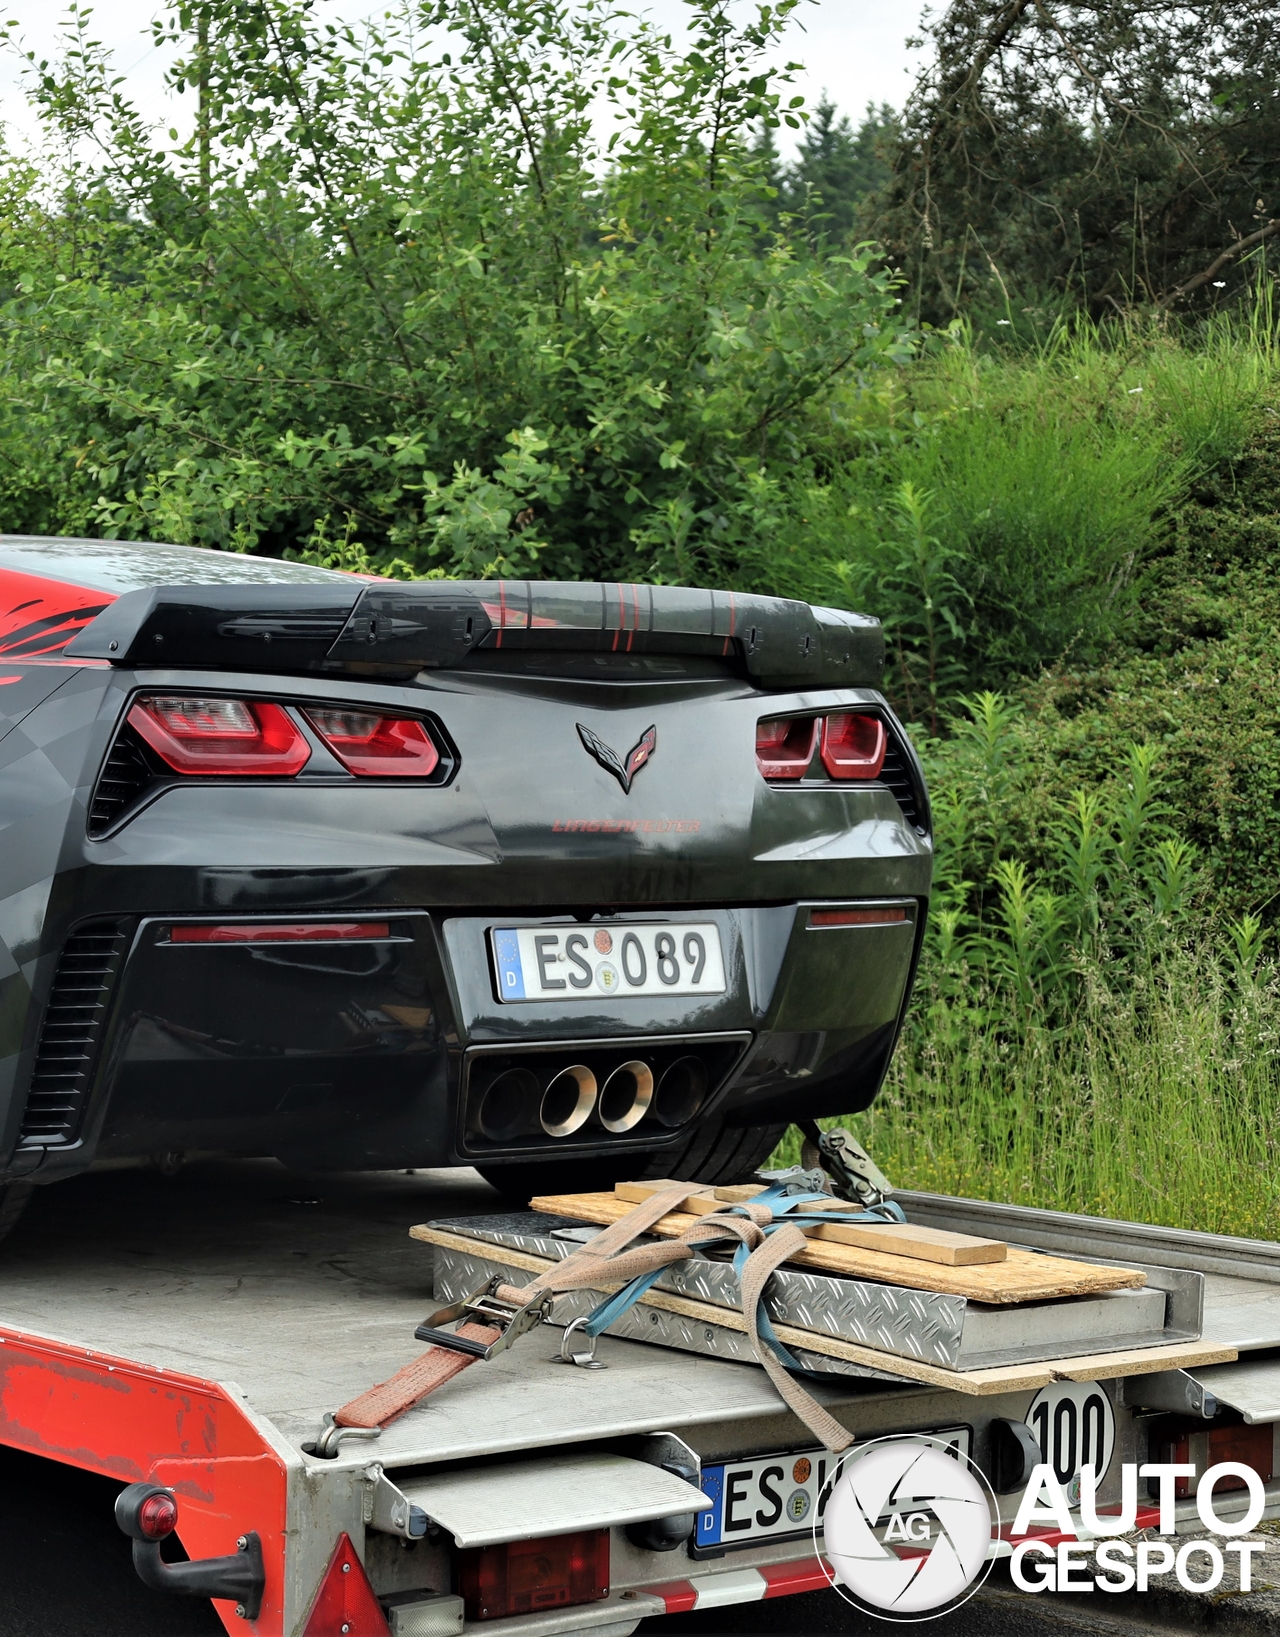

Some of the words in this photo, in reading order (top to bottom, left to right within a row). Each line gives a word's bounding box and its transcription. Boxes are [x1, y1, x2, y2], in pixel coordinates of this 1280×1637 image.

[551, 819, 702, 833] LINGENFELTER
[506, 971, 517, 987] D
[534, 934, 594, 989] ES
[655, 931, 706, 985] 89
[1033, 1393, 1105, 1487] 100
[724, 1466, 784, 1533] ES
[704, 1513, 714, 1531] D
